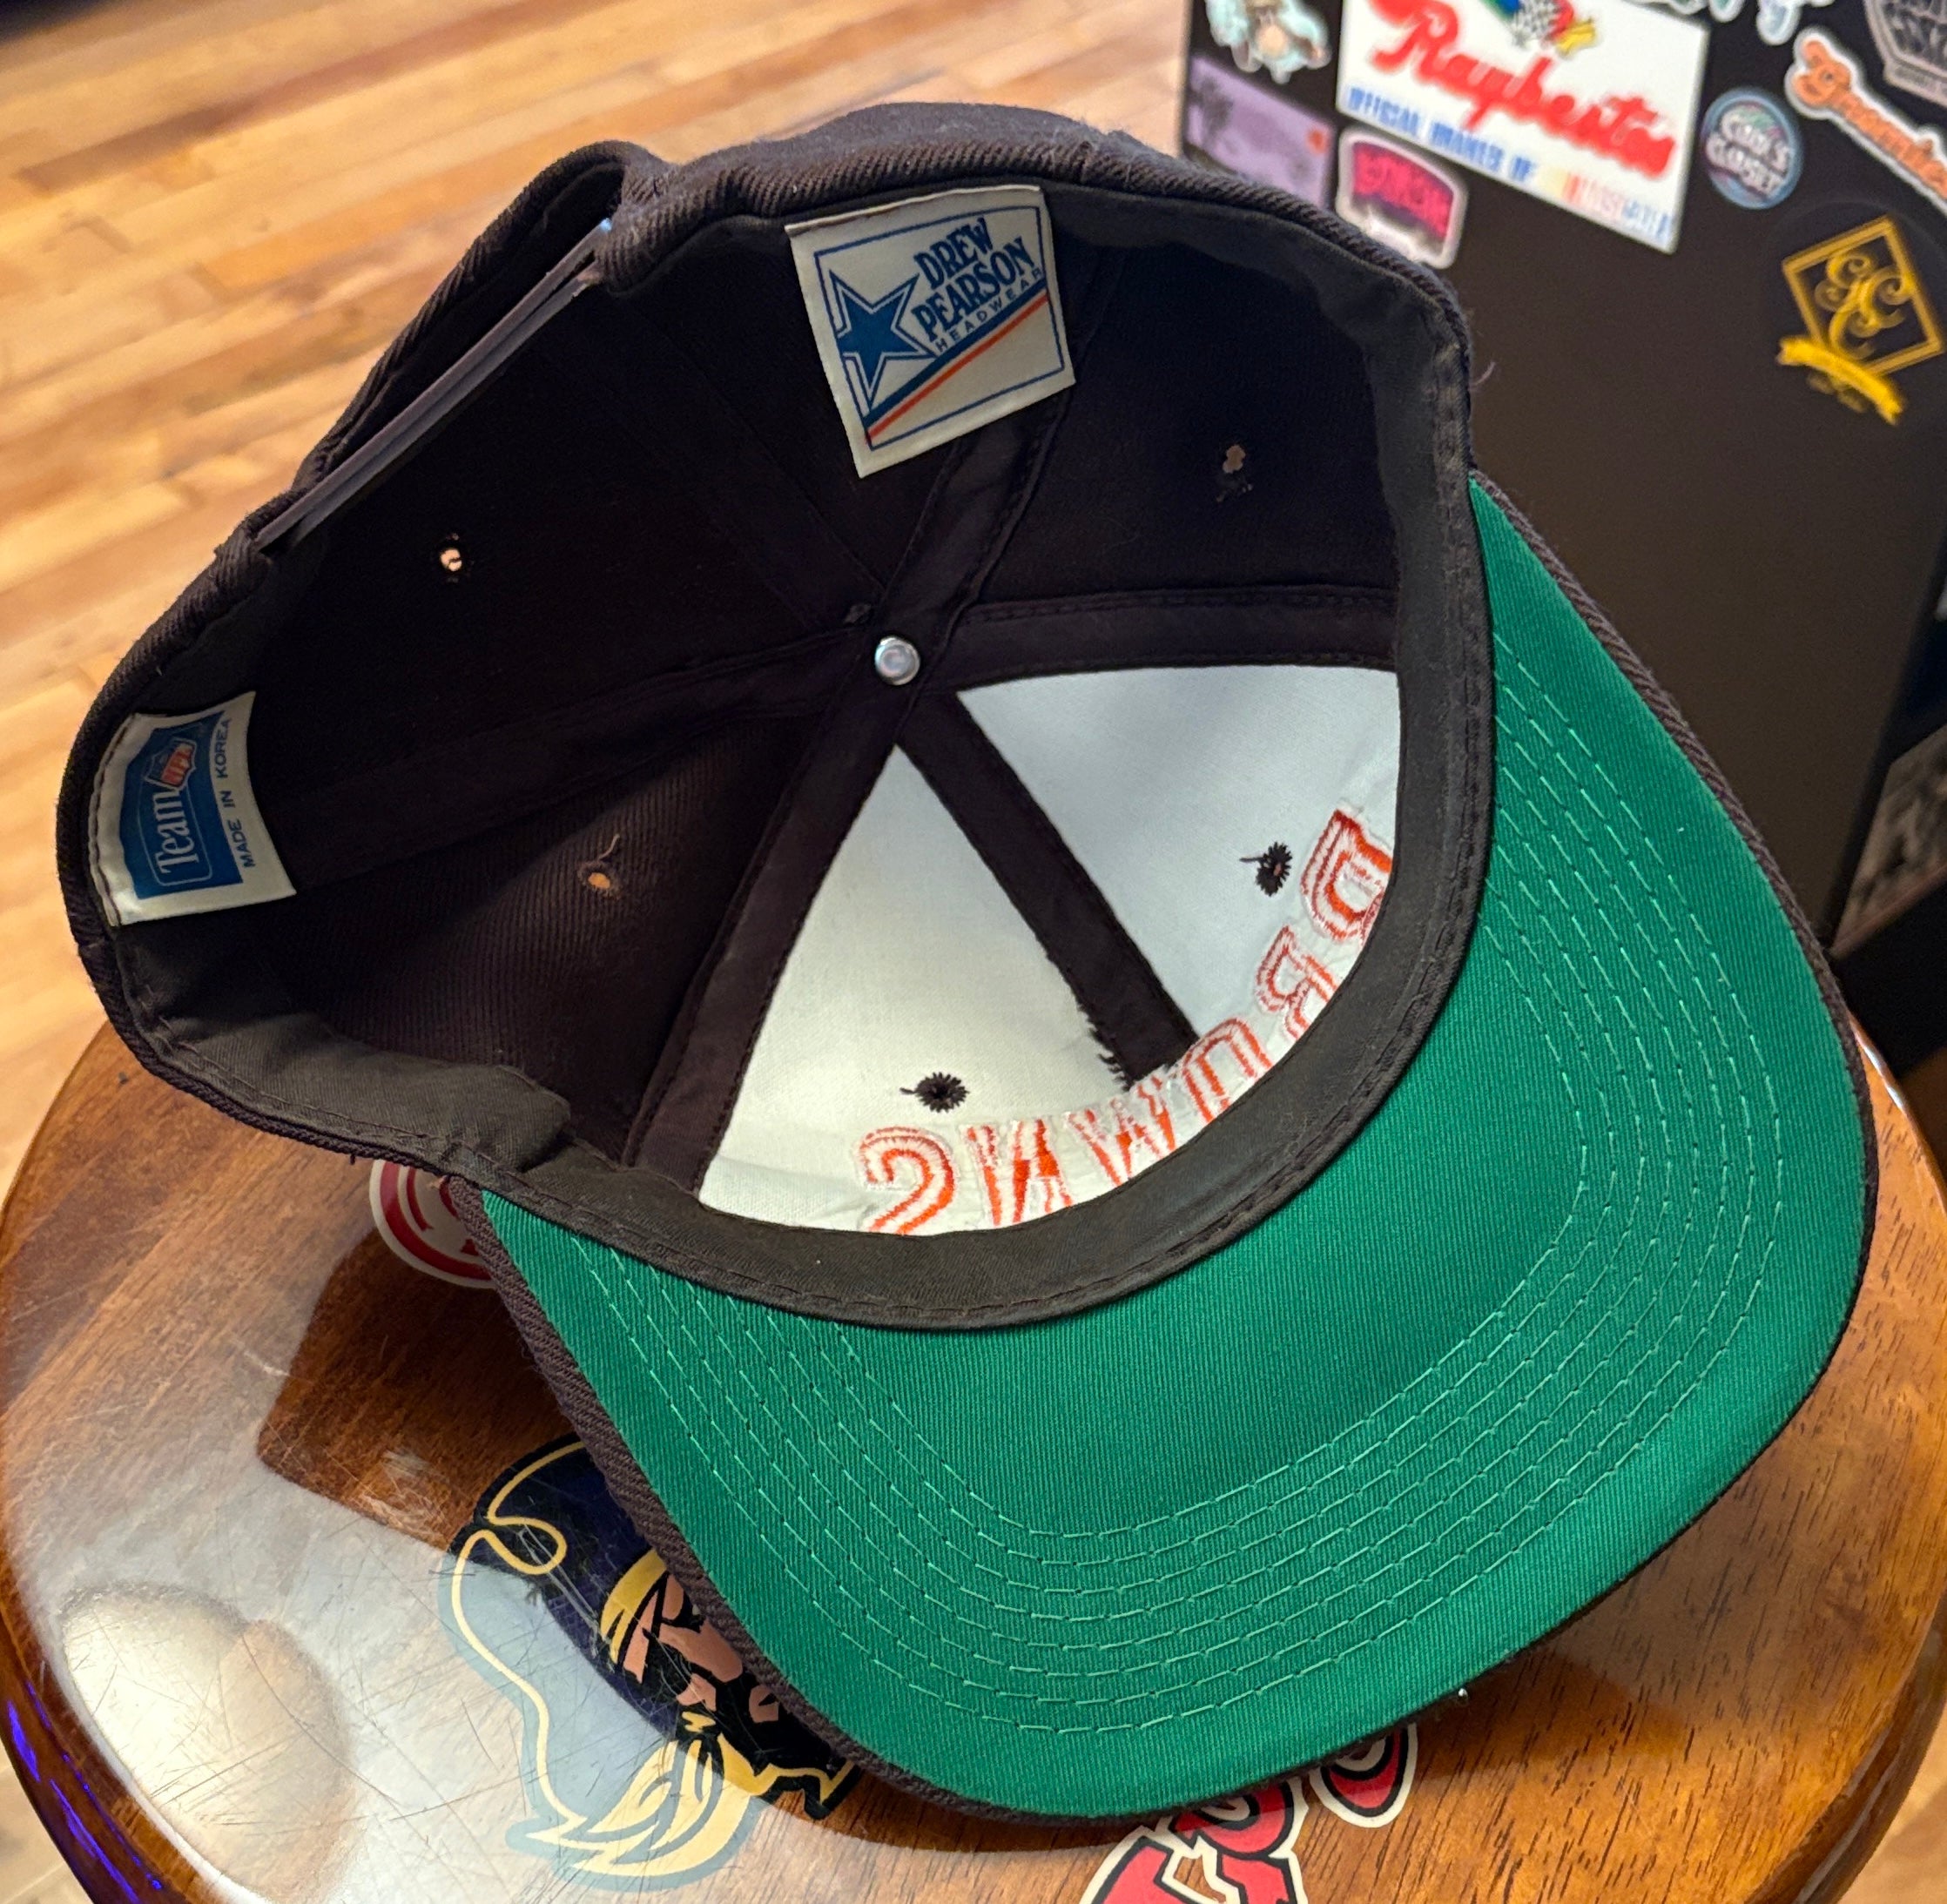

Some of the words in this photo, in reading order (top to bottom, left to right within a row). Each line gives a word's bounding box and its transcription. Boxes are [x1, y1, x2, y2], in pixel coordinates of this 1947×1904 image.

[911, 236, 1035, 344] PEARSON
[913, 215, 994, 291] DREW
[934, 266, 1042, 353] HEADWEAR
[214, 719, 232, 779] KOREA
[153, 788, 200, 875] Team
[219, 790, 236, 809] IN
[227, 818, 256, 868] MADE
